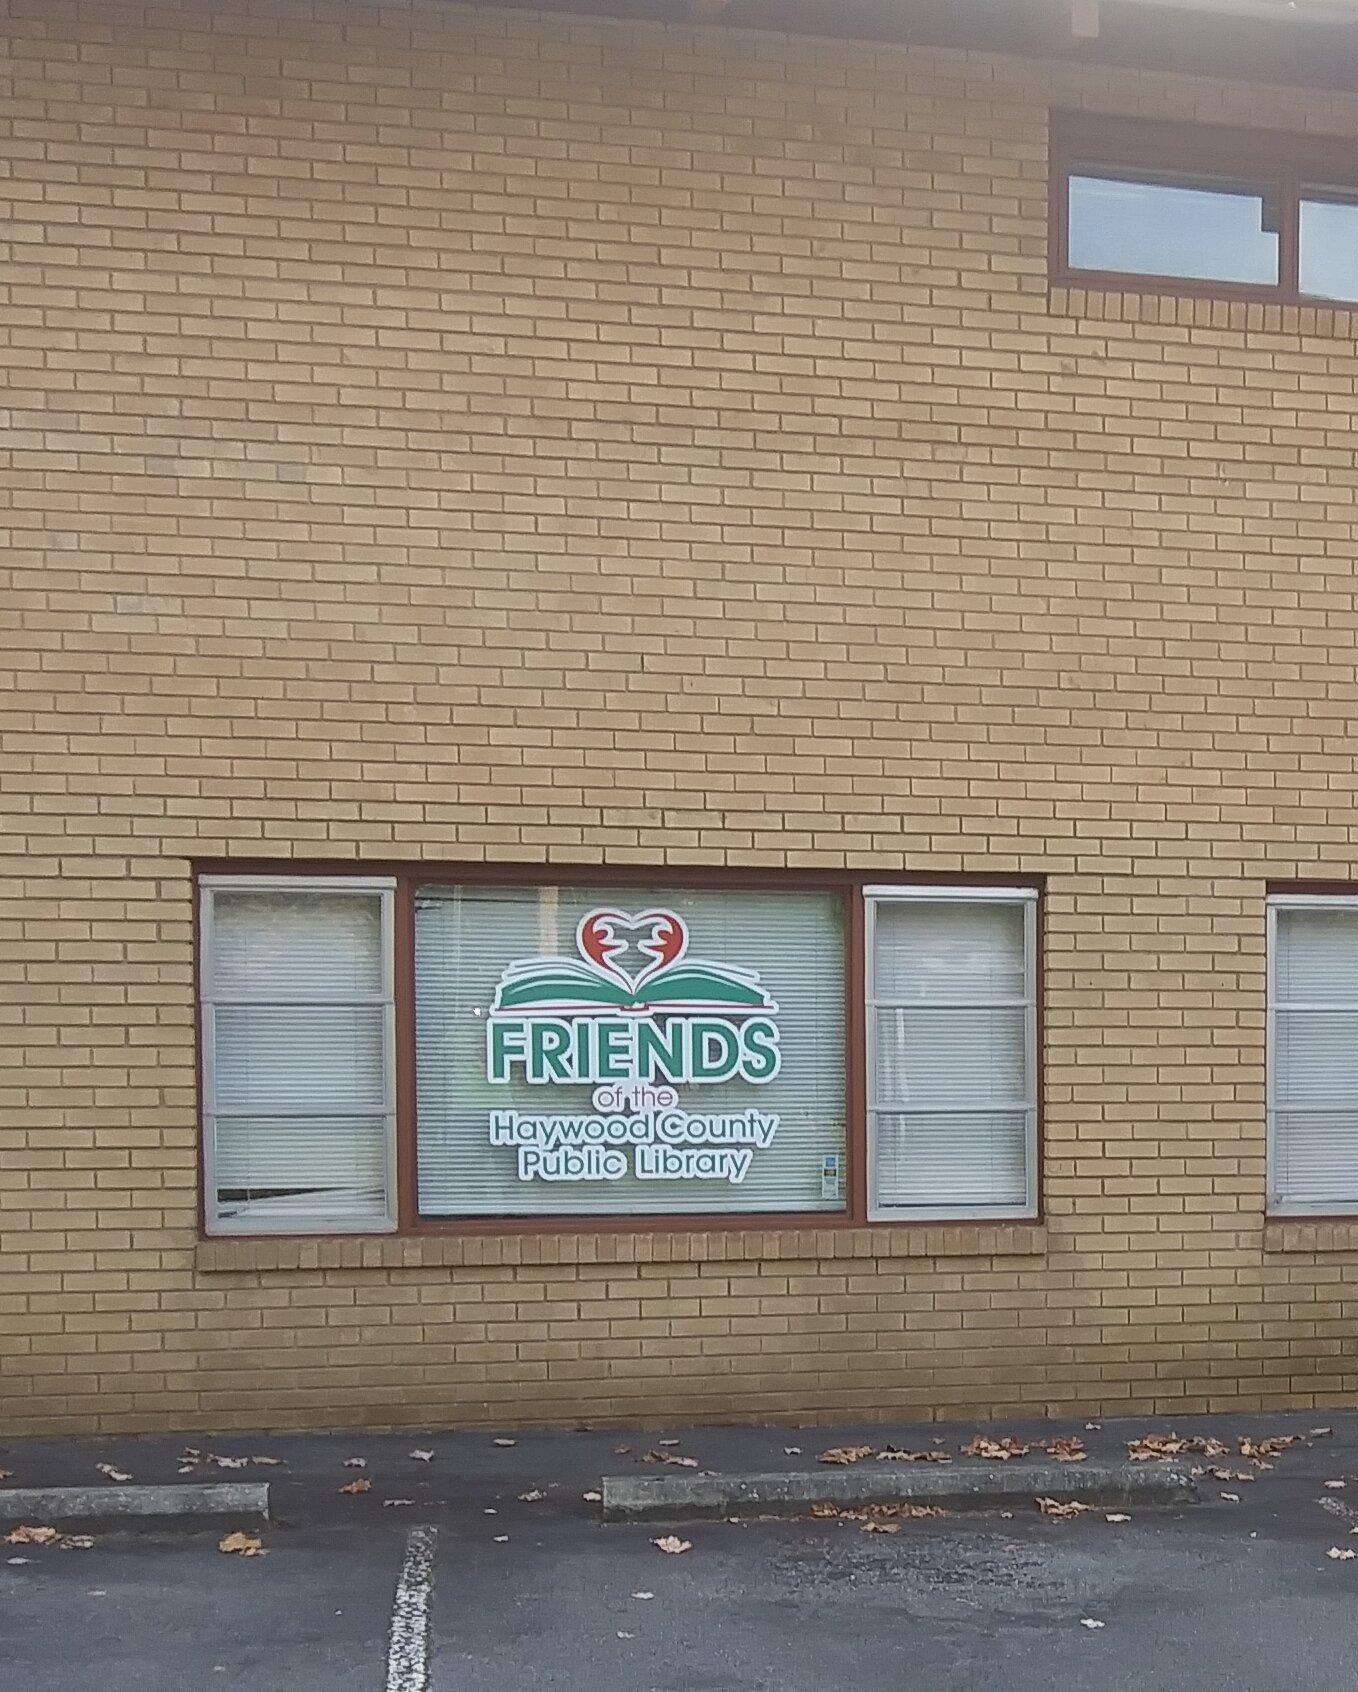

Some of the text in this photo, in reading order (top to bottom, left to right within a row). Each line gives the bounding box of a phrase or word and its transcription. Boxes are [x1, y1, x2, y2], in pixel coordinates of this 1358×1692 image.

[490, 1020, 778, 1080] FRIENDS
[597, 1085, 674, 1108] of the
[494, 1112, 775, 1142] Haywood County
[523, 1149, 748, 1178] Public Library
